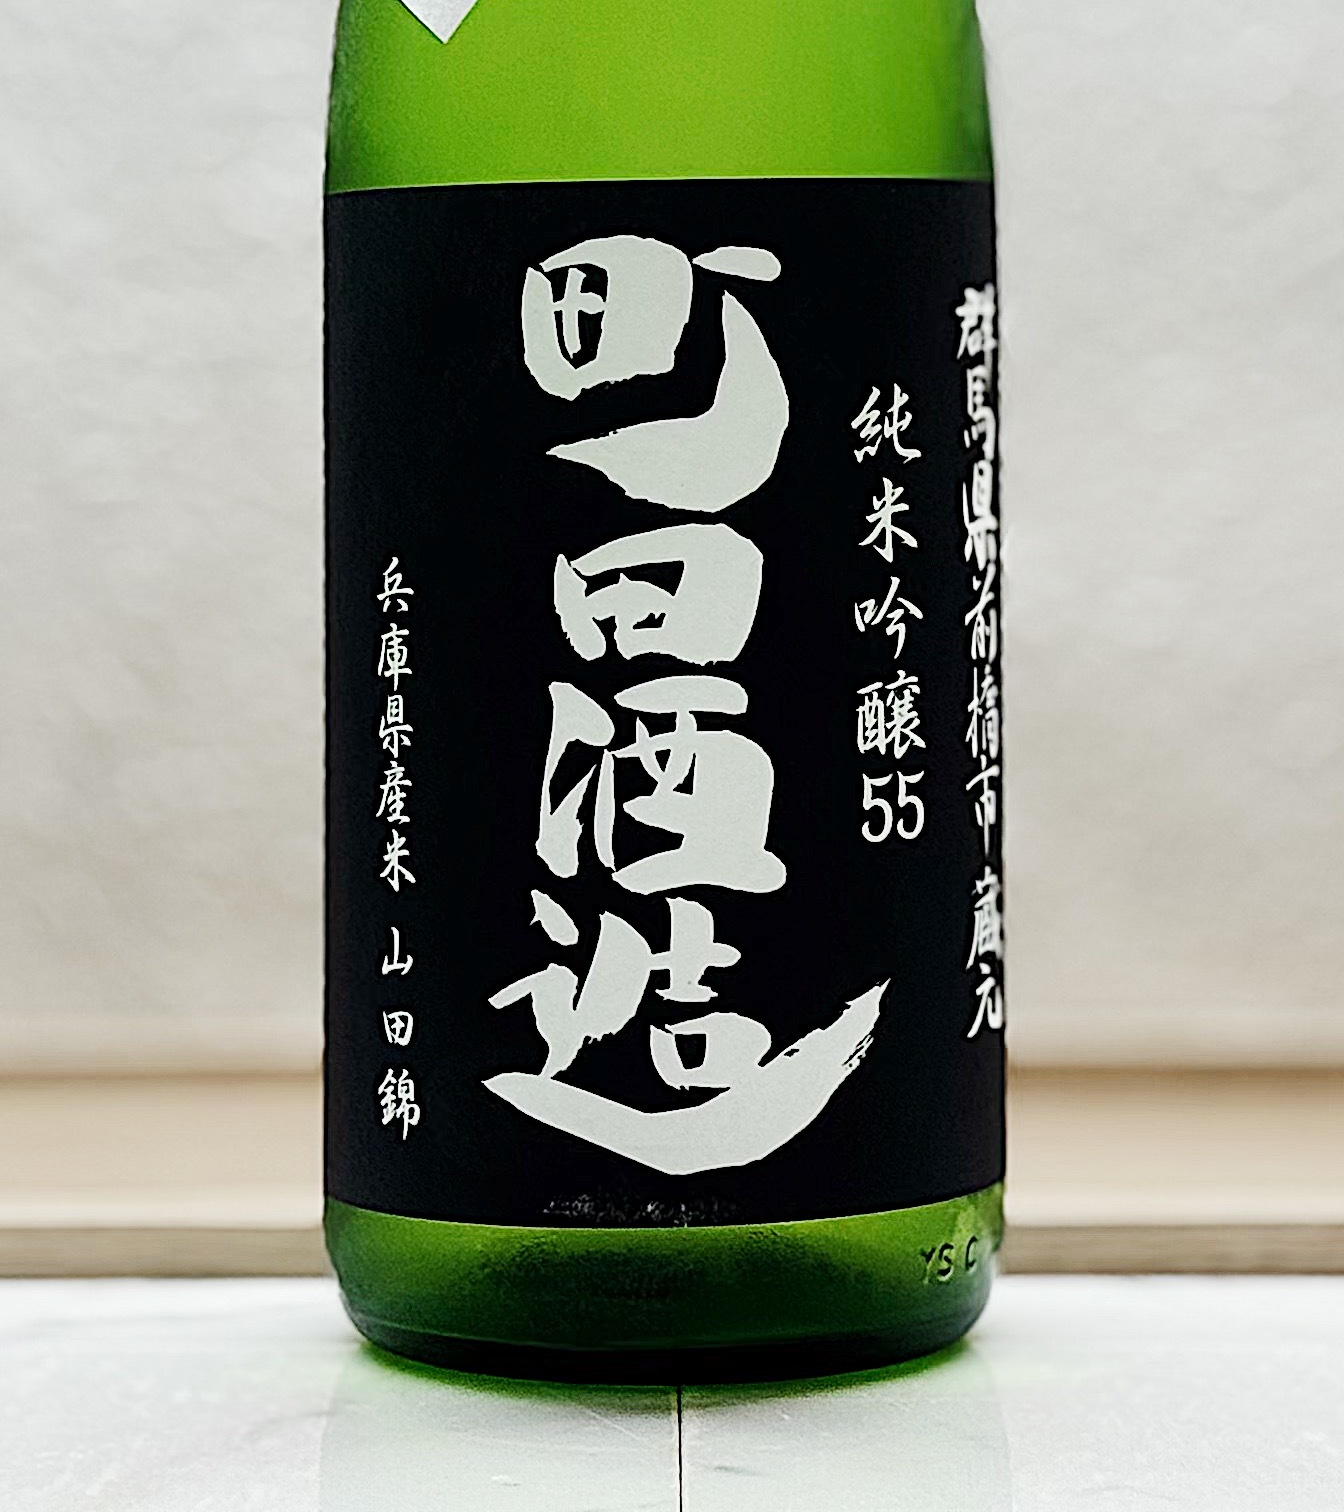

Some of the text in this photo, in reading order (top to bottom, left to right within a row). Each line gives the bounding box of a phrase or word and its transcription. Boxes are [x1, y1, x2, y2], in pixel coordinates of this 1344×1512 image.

[376, 556, 421, 1141] 兵庫県産米 山田錦
[481, 234, 892, 1176] 町田酒造
